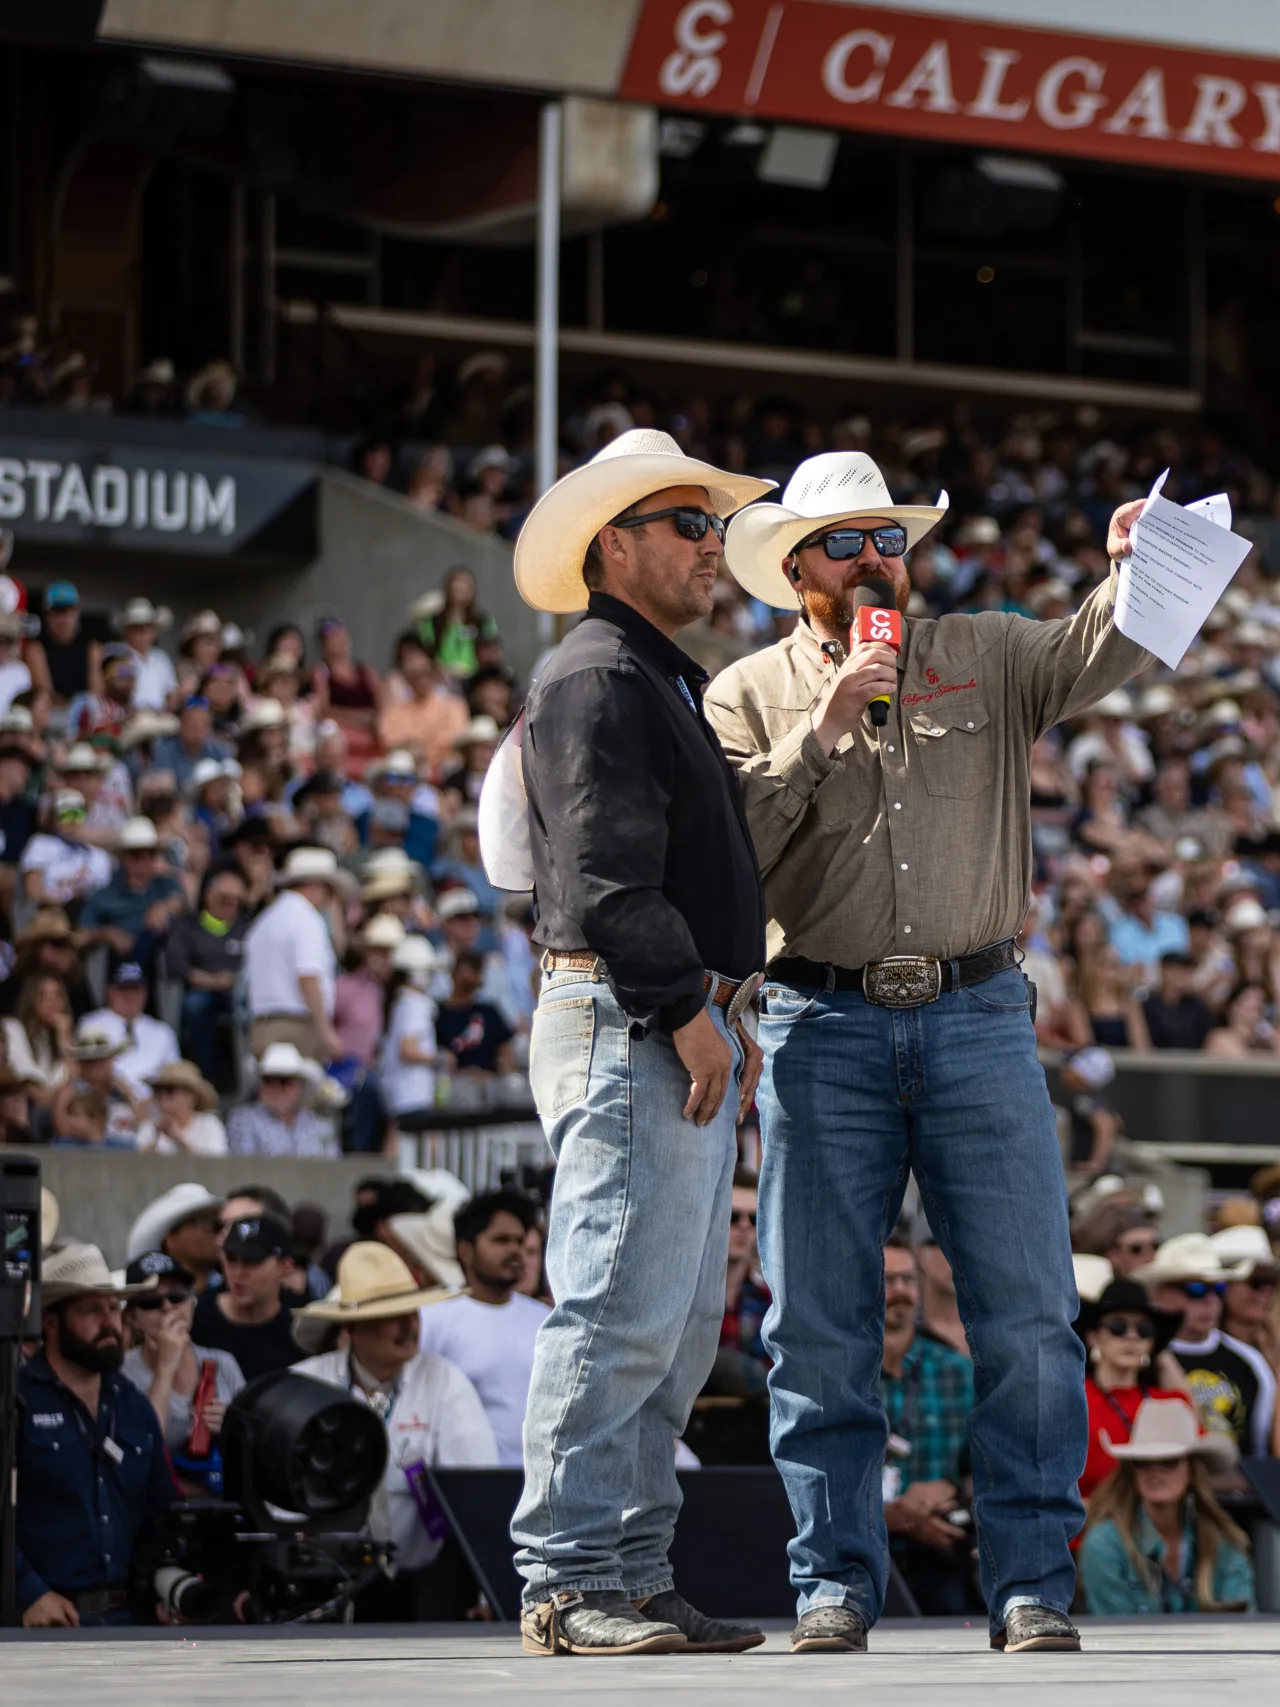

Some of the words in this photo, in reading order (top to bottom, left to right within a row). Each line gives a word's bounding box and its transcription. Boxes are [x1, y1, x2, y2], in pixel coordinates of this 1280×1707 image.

[0, 457, 236, 536] STADIUM
[901, 693, 934, 706] Calgary
[935, 678, 976, 698] Stampede
